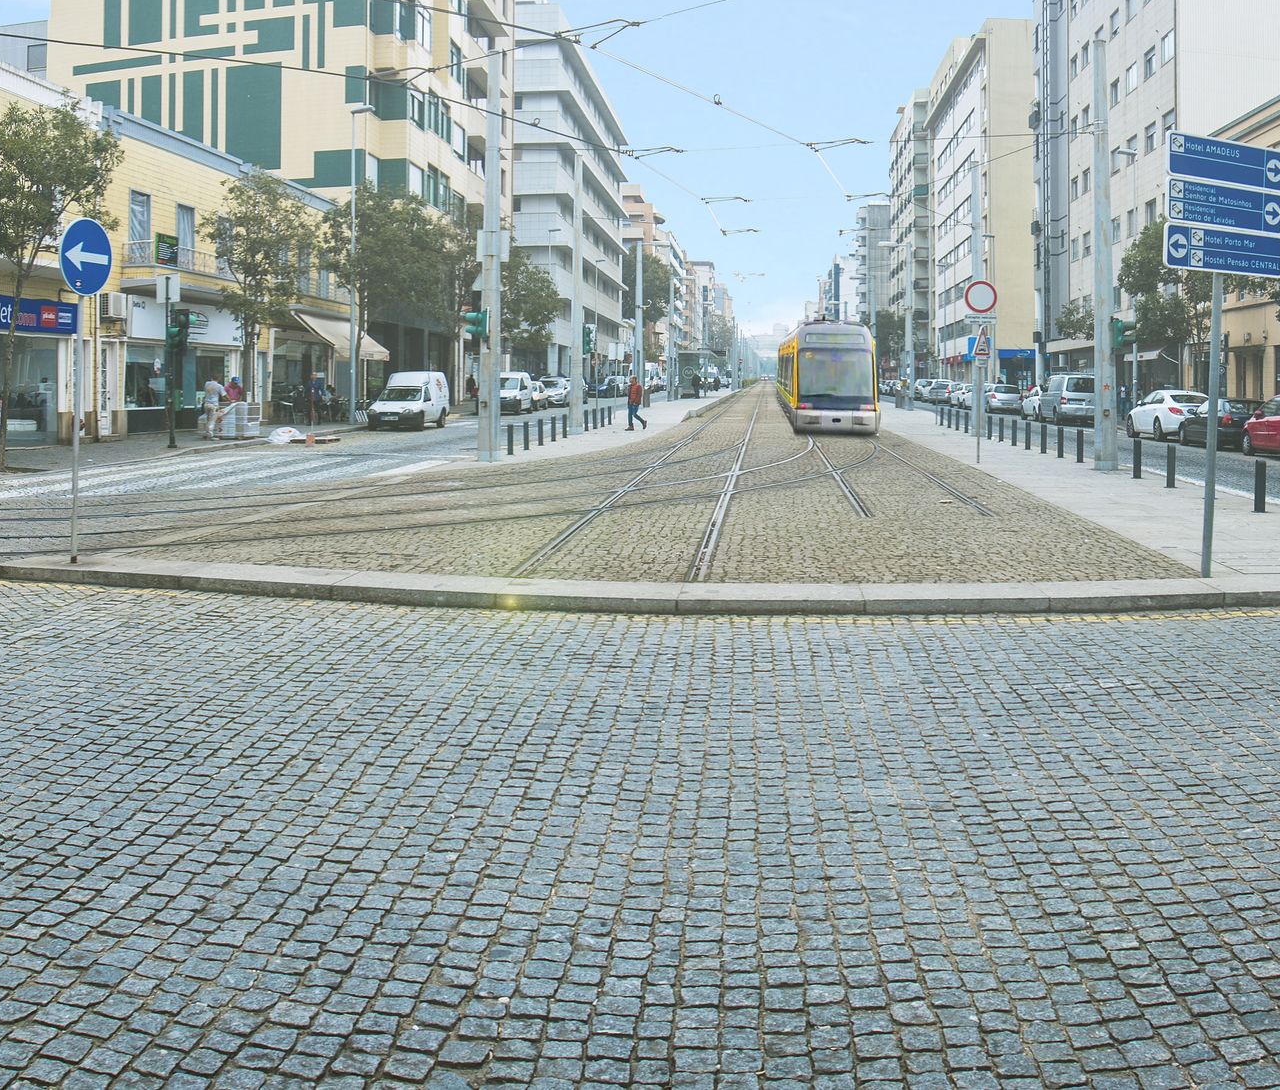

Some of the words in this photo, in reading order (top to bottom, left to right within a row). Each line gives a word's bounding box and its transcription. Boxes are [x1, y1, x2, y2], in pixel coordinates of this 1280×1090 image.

[1185, 141, 1204, 152] Hotel
[1205, 145, 1240, 158] AMADEUS
[1184, 182, 1216, 194] Residencial
[1184, 191, 1207, 201] Senhor
[1208, 195, 1217, 203] de
[1218, 196, 1252, 208] Matosinhos
[1184, 203, 1216, 214] Residencial
[1184, 211, 1202, 221] Porto
[1203, 214, 1212, 223] de
[1213, 215, 1236, 226] Leixões
[1205, 235, 1223, 245] Hotel
[1224, 237, 1242, 248] Porto
[1243, 239, 1256, 249] Mar
[1204, 255, 1225, 265] Hostel
[1227, 257, 1249, 268] Pensão
[1250, 260, 1280, 271] CENTRAL
